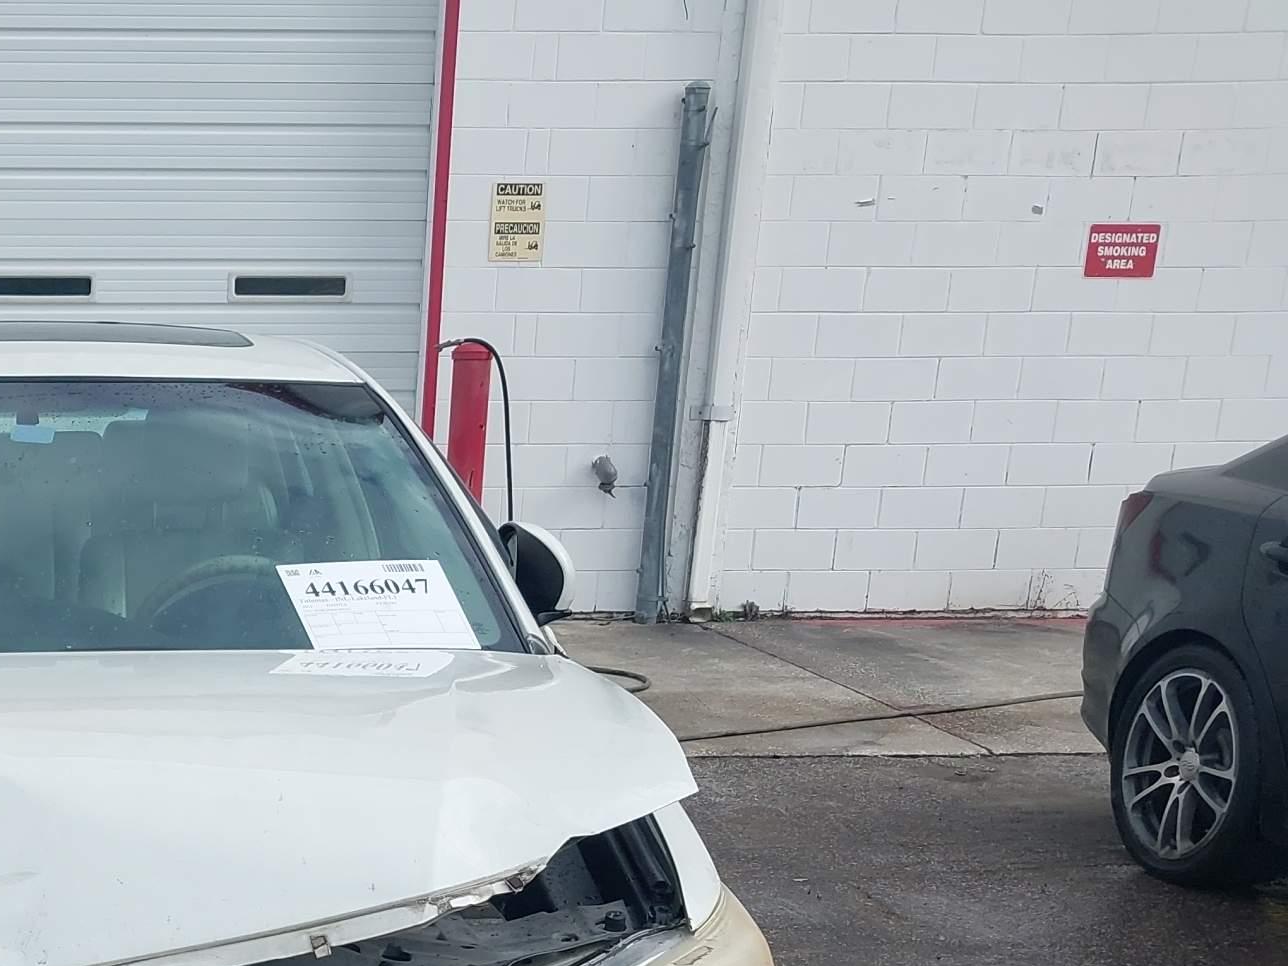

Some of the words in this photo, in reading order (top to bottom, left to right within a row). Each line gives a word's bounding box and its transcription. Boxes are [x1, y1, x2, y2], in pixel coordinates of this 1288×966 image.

[498, 184, 541, 195] CAUTION
[495, 223, 539, 234] PRECAUCION
[1091, 233, 1157, 243] DESIGNATED
[1097, 246, 1146, 256] SMOKING
[1105, 259, 1134, 269] AREA
[305, 577, 429, 597] 44166047
